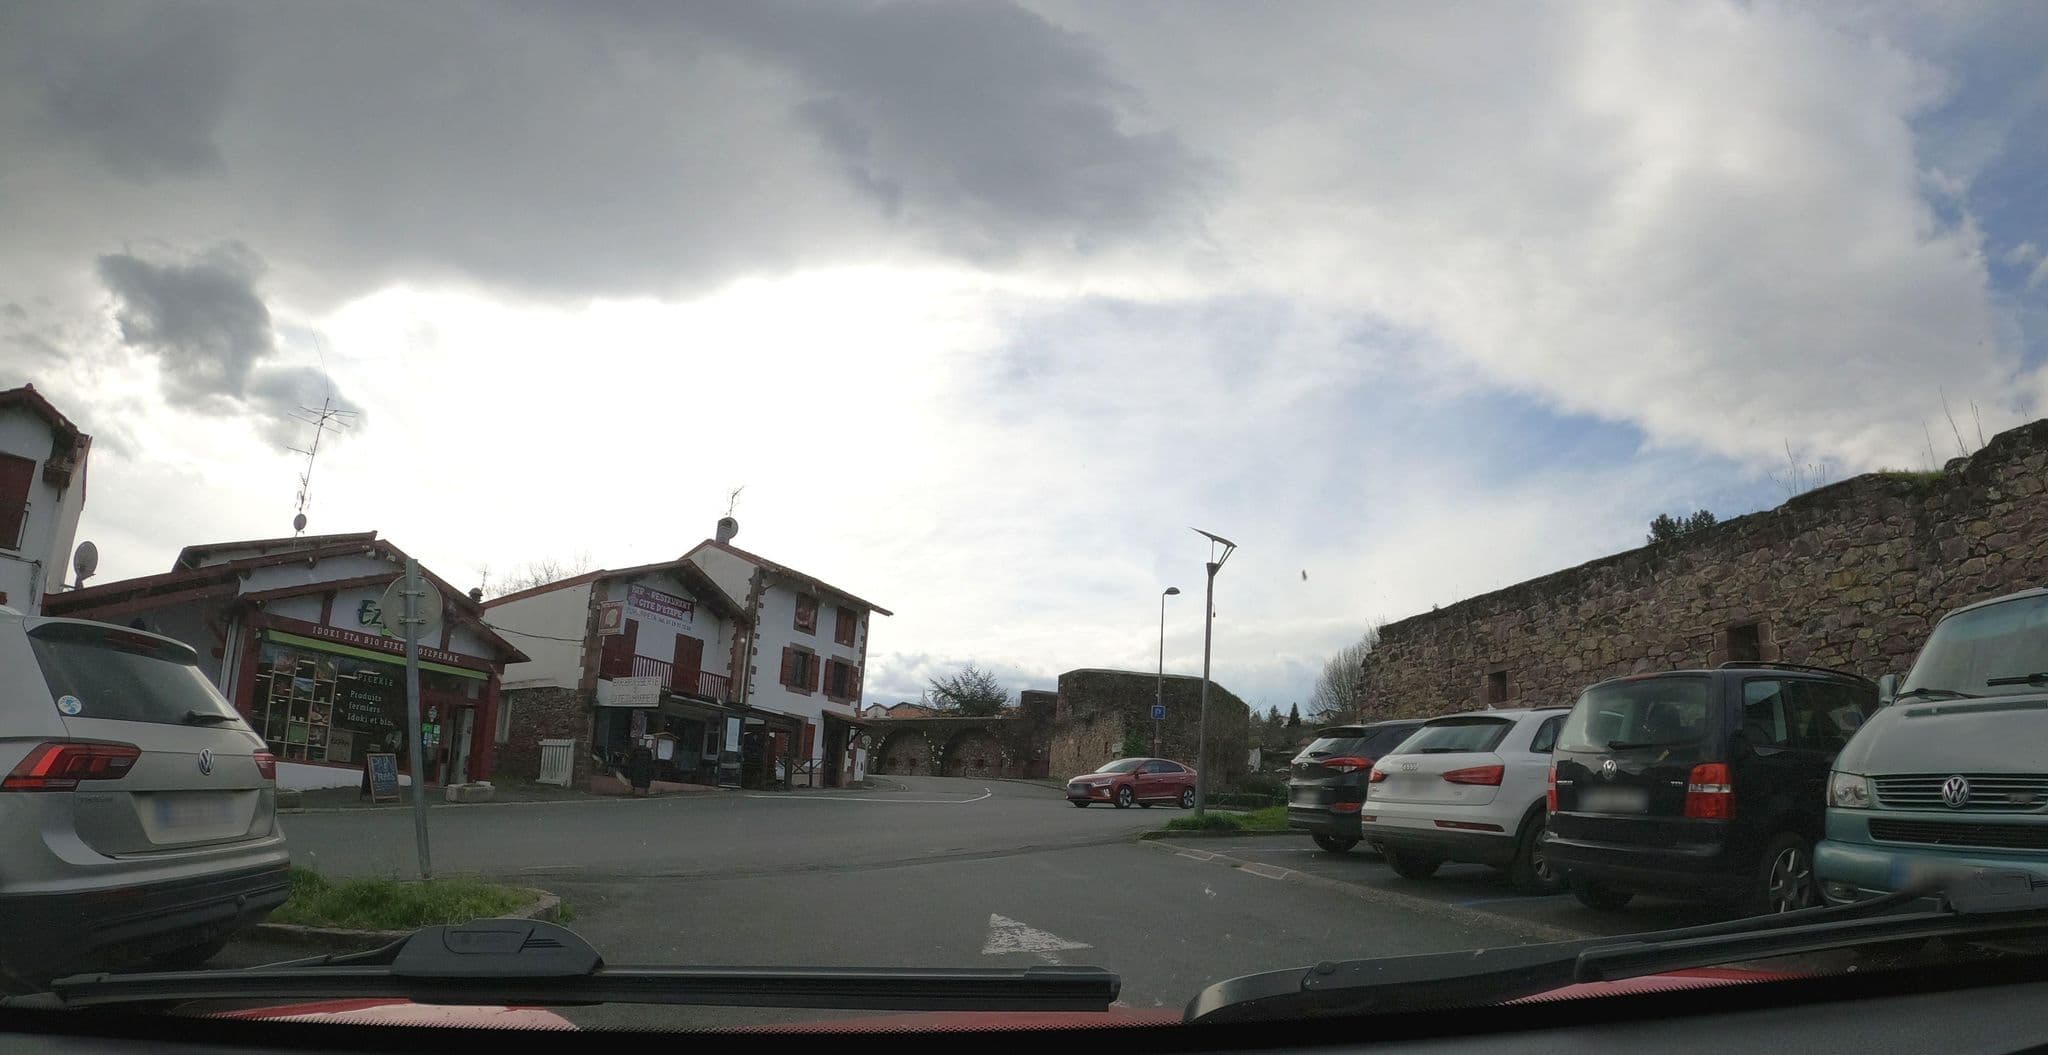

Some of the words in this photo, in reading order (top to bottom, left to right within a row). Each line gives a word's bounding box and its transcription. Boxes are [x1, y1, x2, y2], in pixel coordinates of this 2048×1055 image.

[312, 626, 340, 639] IDOKI
[344, 632, 360, 643] ETA
[364, 636, 380, 647] BIO
[350, 689, 382, 702] Produits
[347, 712, 368, 724] Idoki
